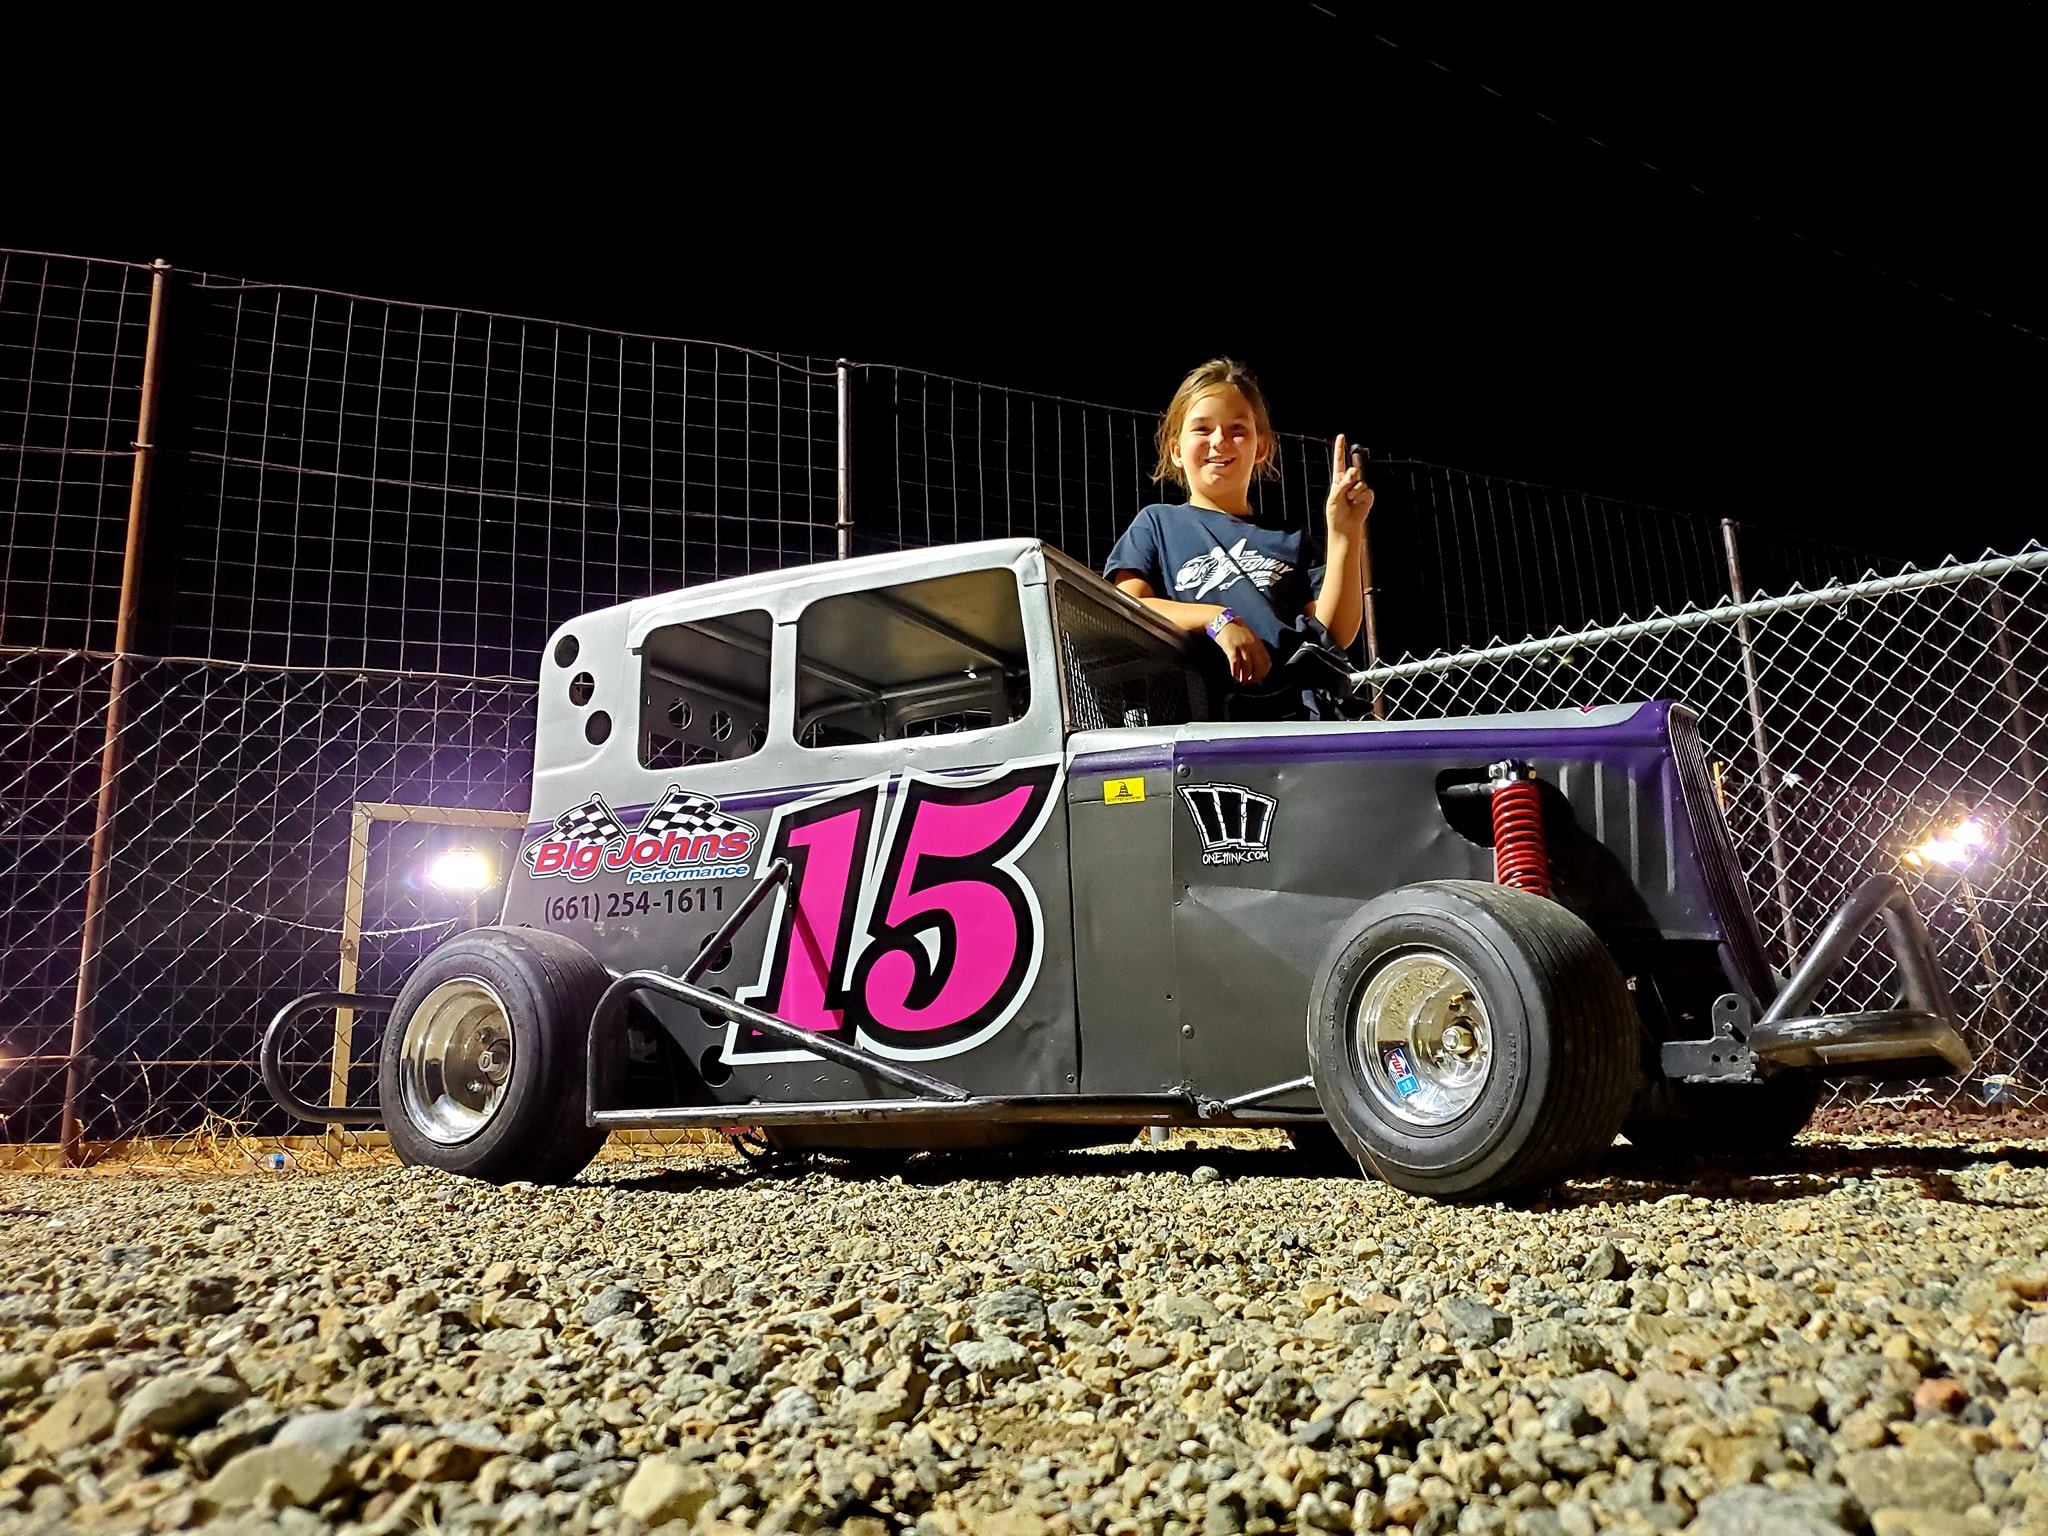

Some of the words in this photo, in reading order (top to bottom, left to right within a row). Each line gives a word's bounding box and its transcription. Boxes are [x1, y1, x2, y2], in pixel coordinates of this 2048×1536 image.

[533, 839, 604, 877] Big
[607, 830, 751, 867] Johns
[628, 864, 749, 883] Performance
[544, 892, 601, 924] (661)
[606, 885, 723, 918] 254-1611
[722, 756, 1070, 1060] 15
